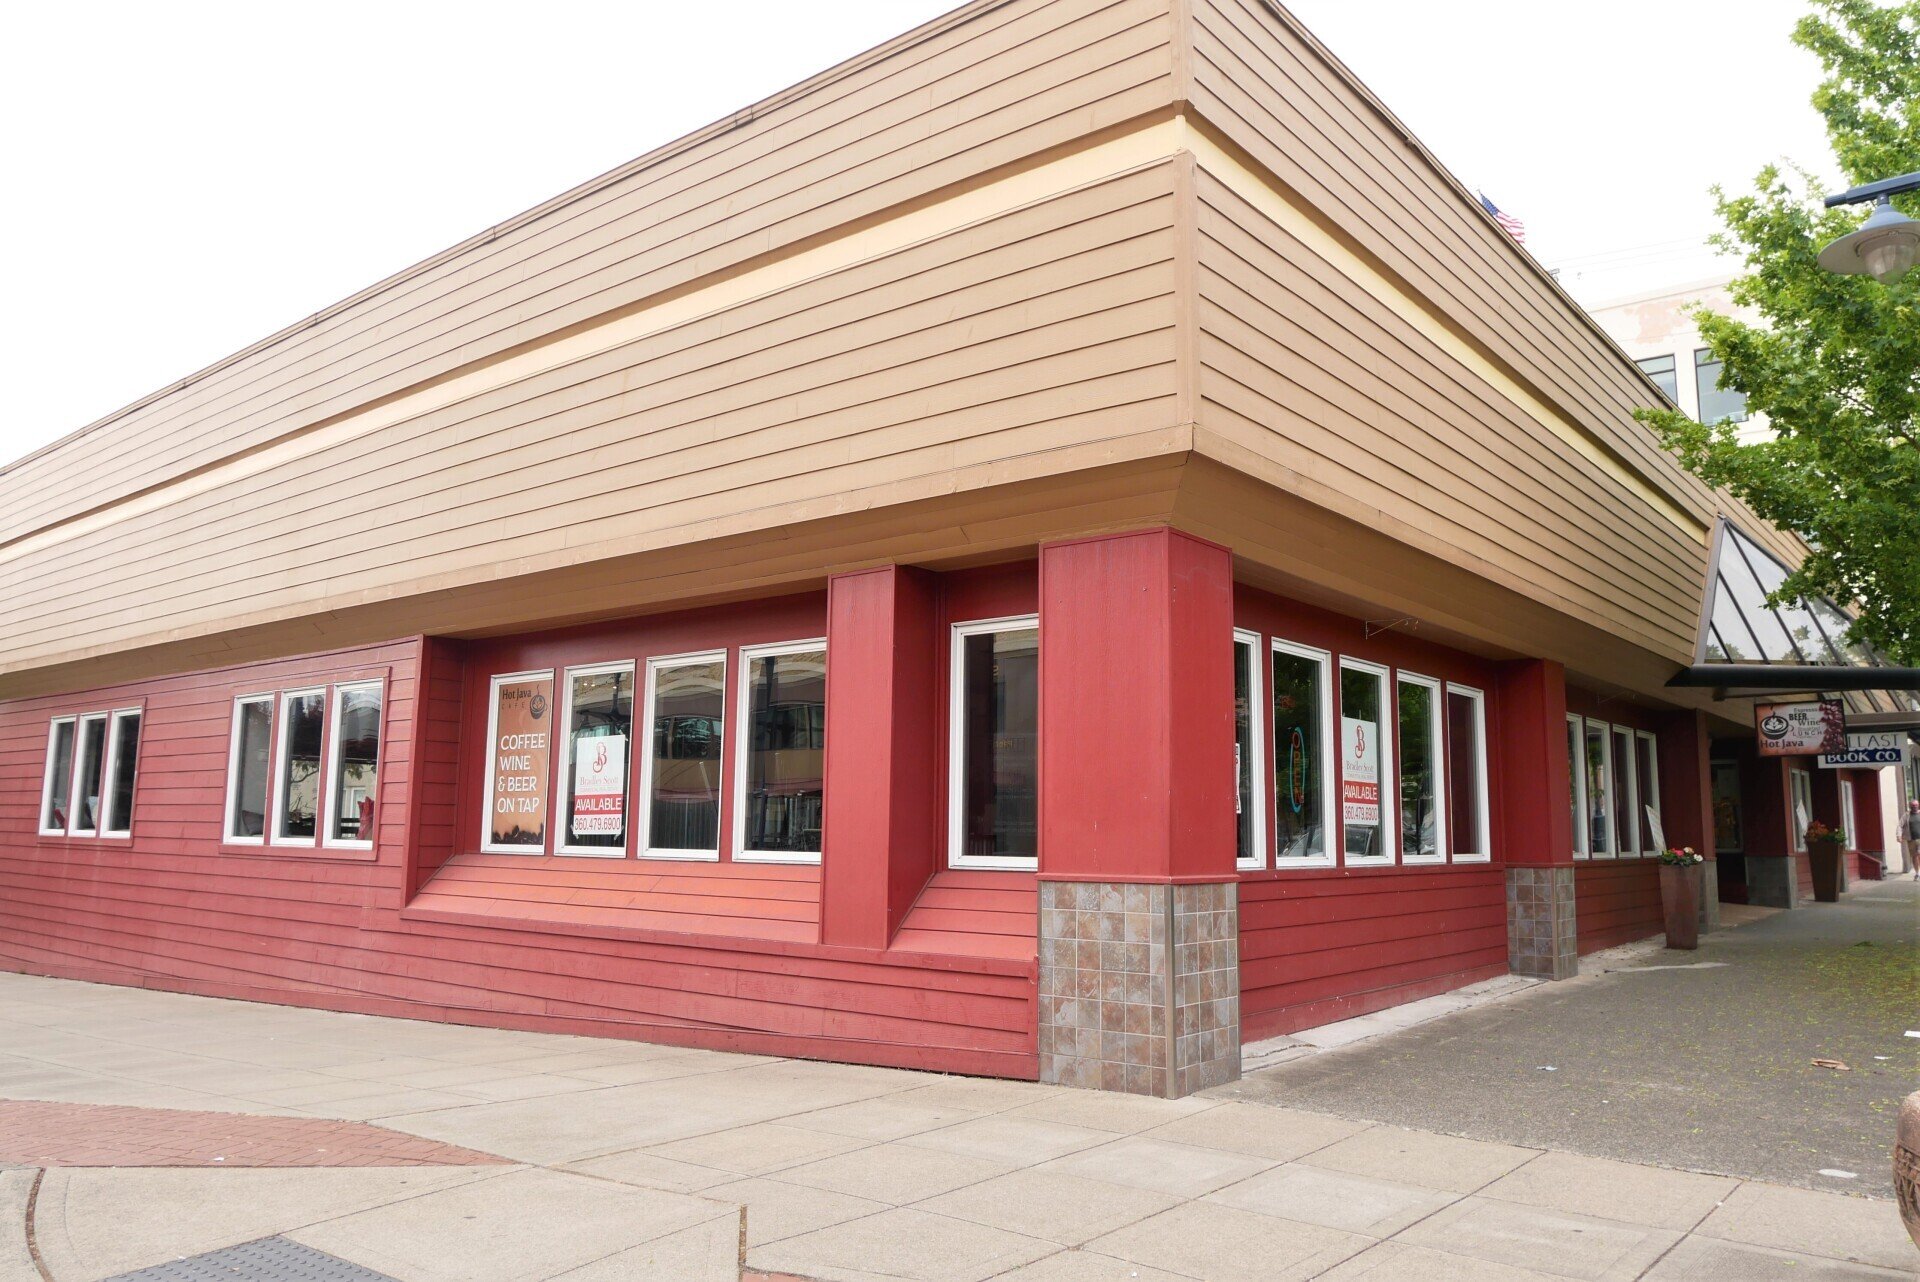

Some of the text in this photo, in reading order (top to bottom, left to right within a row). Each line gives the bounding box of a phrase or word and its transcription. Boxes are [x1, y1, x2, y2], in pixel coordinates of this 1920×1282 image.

[502, 688, 532, 700] Hot Java
[1788, 712, 1808, 720] BEER
[1798, 718, 1820, 726] Wine
[500, 733, 546, 750] COFFEE
[1760, 739, 1804, 749] Hot Java
[1848, 732, 1899, 748] LLAST
[500, 755, 531, 771] WINE
[1827, 750, 1900, 763] BOOK CO.
[498, 776, 537, 792] & BEER
[604, 776, 618, 784] Scott
[1344, 785, 1378, 800] AVAILABLE
[498, 797, 540, 813] ON TAP
[575, 798, 622, 812] AVAILABLE
[574, 817, 621, 831] 360.479.6900
